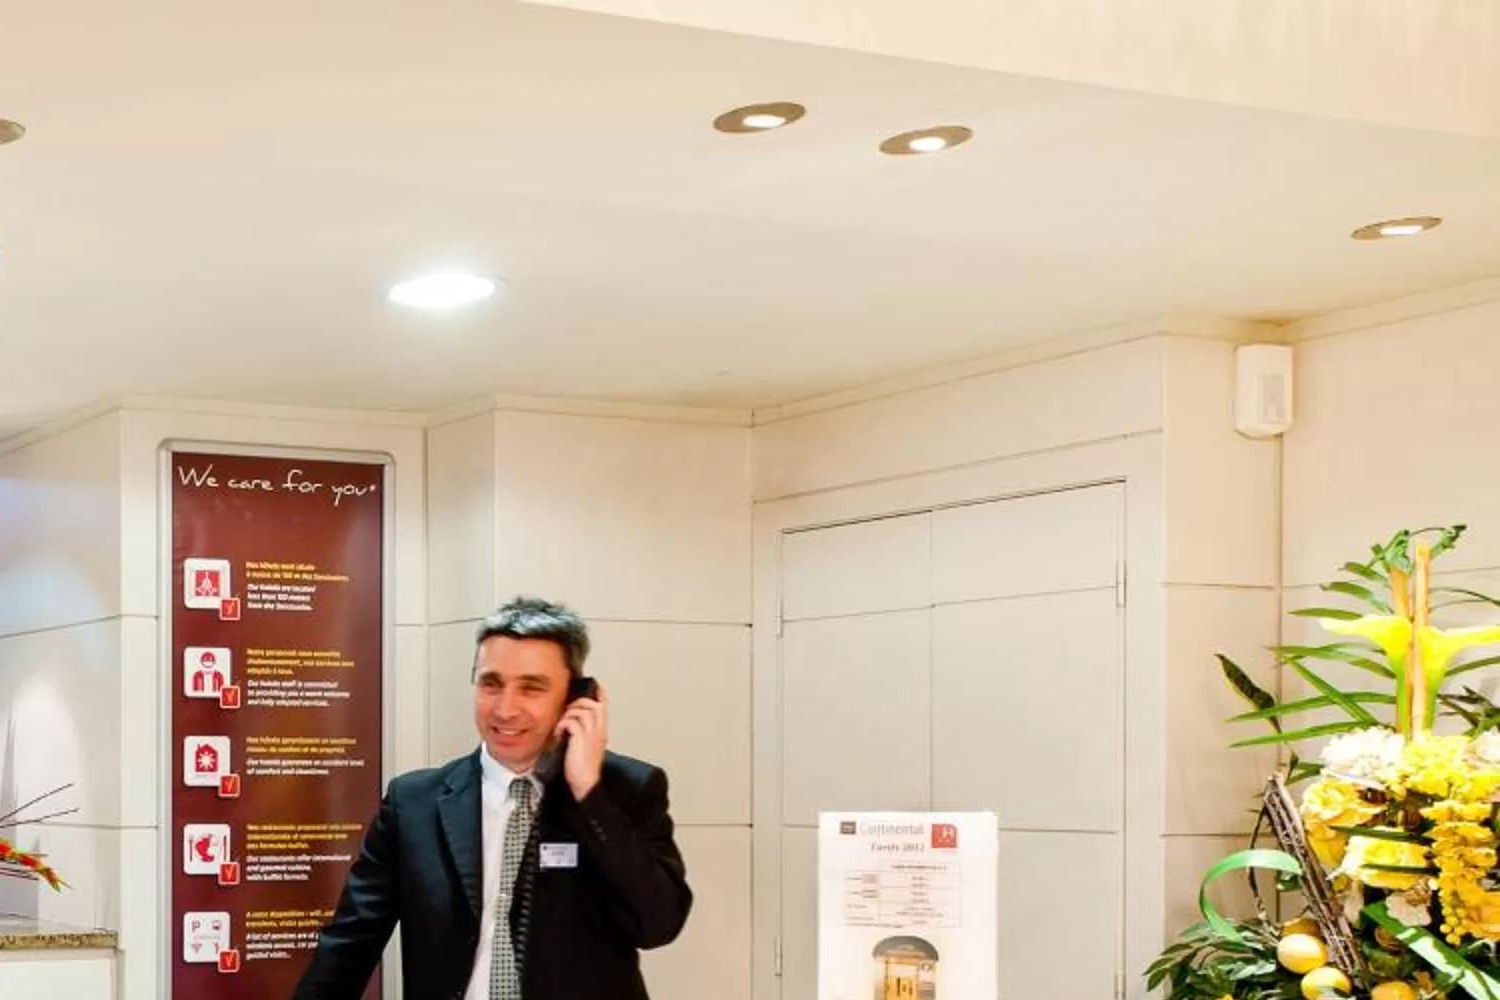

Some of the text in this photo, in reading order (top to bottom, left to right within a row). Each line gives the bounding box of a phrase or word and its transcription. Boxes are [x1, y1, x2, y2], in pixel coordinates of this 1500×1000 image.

[177, 464, 219, 487] We
[227, 476, 274, 491] care
[282, 469, 322, 492] for
